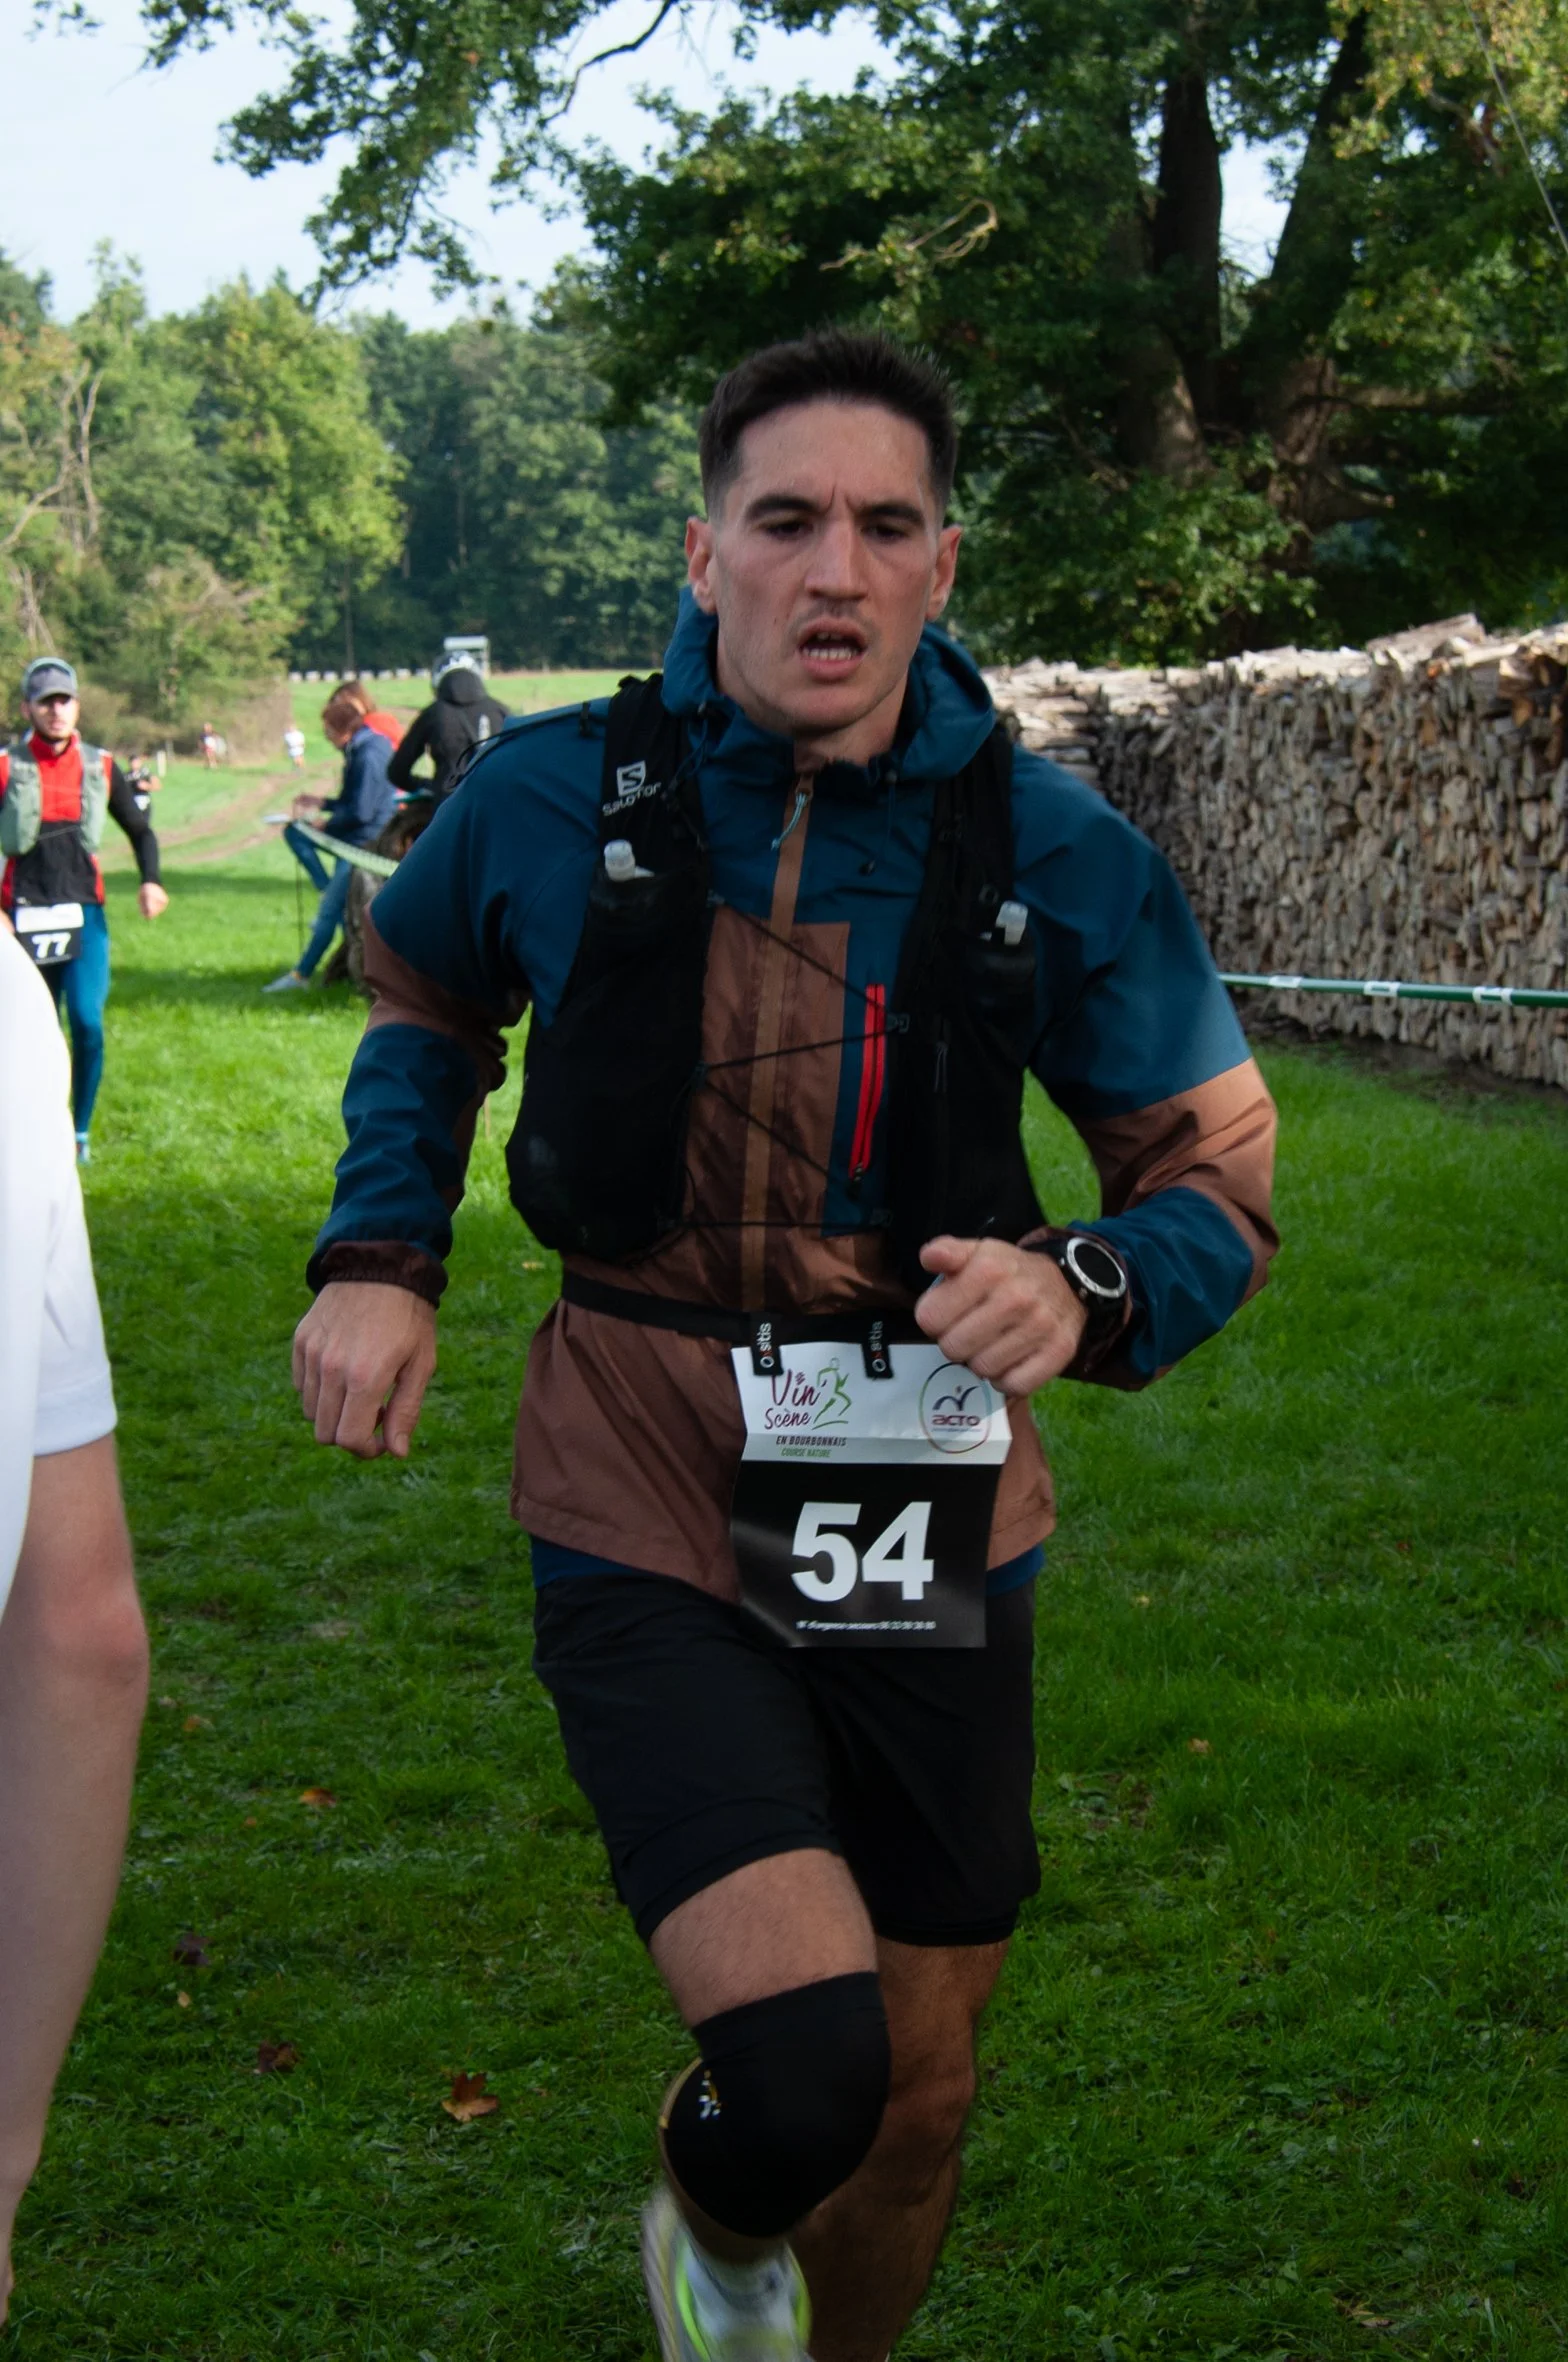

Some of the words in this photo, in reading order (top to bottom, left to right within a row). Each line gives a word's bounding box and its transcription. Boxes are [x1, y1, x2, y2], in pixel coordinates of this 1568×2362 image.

[32, 932, 71, 958] 77
[764, 1408, 812, 1430] Scène
[776, 1435, 787, 1446] EN
[789, 1435, 847, 1447] BOURBONNAIS
[791, 1501, 935, 1602] 54
